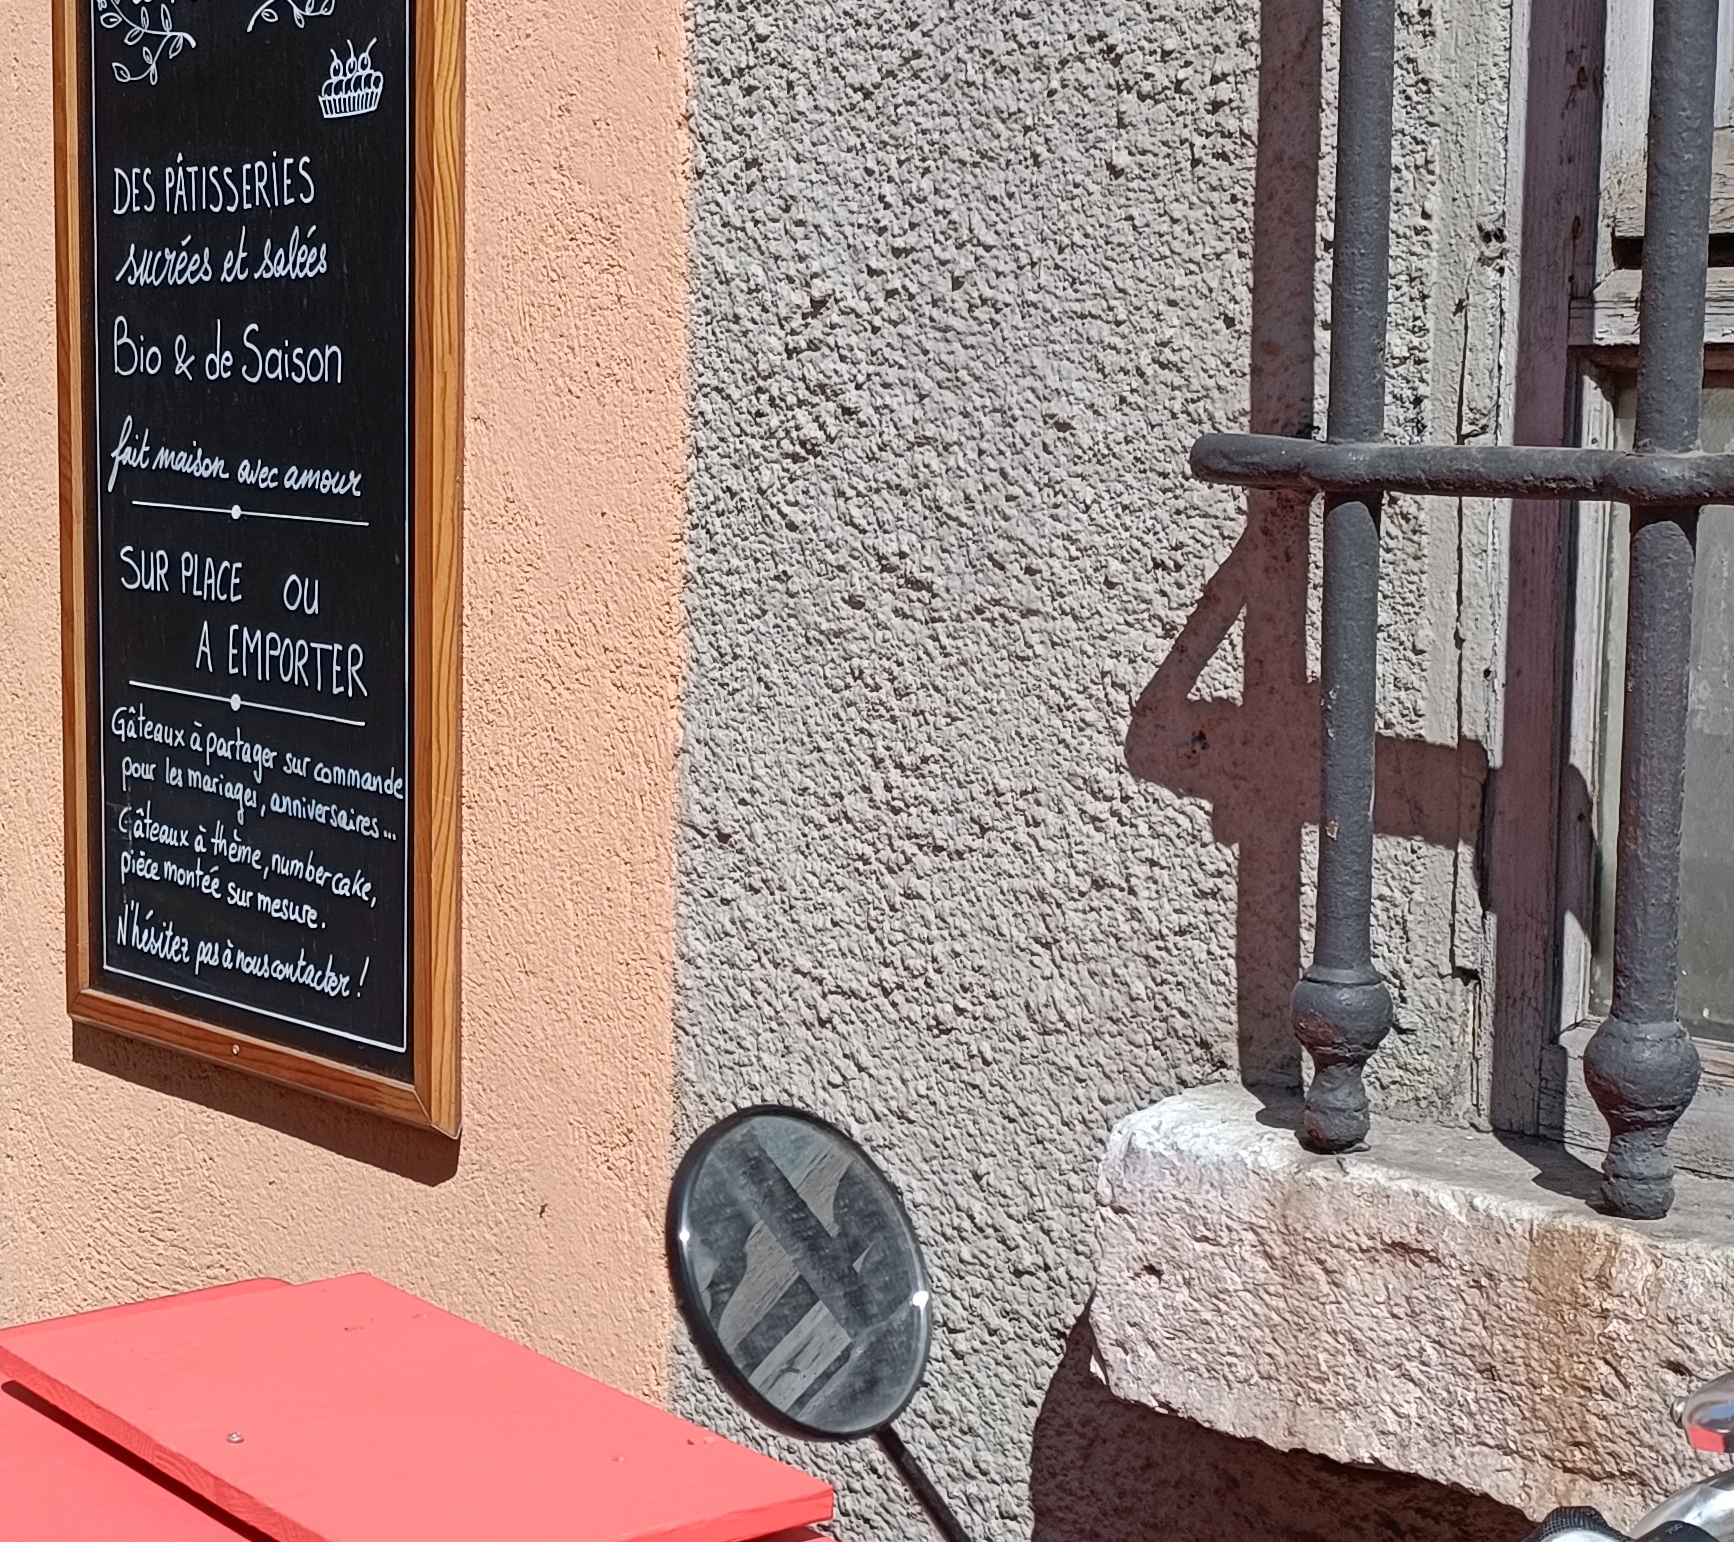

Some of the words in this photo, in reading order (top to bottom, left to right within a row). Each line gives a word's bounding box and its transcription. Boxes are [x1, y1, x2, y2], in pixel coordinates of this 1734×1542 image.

[113, 167, 156, 214] DES
[165, 150, 316, 214] PÂTISSERIES
[116, 235, 213, 286] sucrées
[221, 225, 248, 282] et
[253, 225, 328, 279] salées
[114, 316, 162, 376] Bio
[174, 335, 195, 381] &
[205, 319, 234, 380] de
[242, 323, 343, 384] Saison
[108, 414, 151, 492] fait
[153, 440, 229, 479] maison
[238, 459, 279, 489] avec
[284, 465, 361, 497] amour
[120, 546, 169, 592] SUR
[181, 552, 243, 602] PLACE
[284, 574, 318, 614] OU
[196, 621, 213, 673] A
[229, 624, 368, 697] EMPORTER
[111, 703, 185, 743] Gâteaux
[190, 721, 203, 752] à
[206, 727, 277, 784] partager
[283, 752, 311, 777] sur
[314, 767, 404, 799] commande
[122, 757, 156, 791] pour
[166, 757, 183, 786] les
[188, 768, 266, 825] mariages,
[194, 825, 207, 853] à
[211, 821, 269, 879] thème,
[121, 850, 160, 885] pièce
[164, 858, 221, 899] montée
[227, 881, 253, 908] sur
[257, 894, 326, 929] mesure.
[117, 900, 189, 963] N'hésitez
[195, 942, 220, 975] pas
[222, 940, 234, 970] à
[236, 946, 271, 979] nous
[271, 949, 351, 997] contacter
